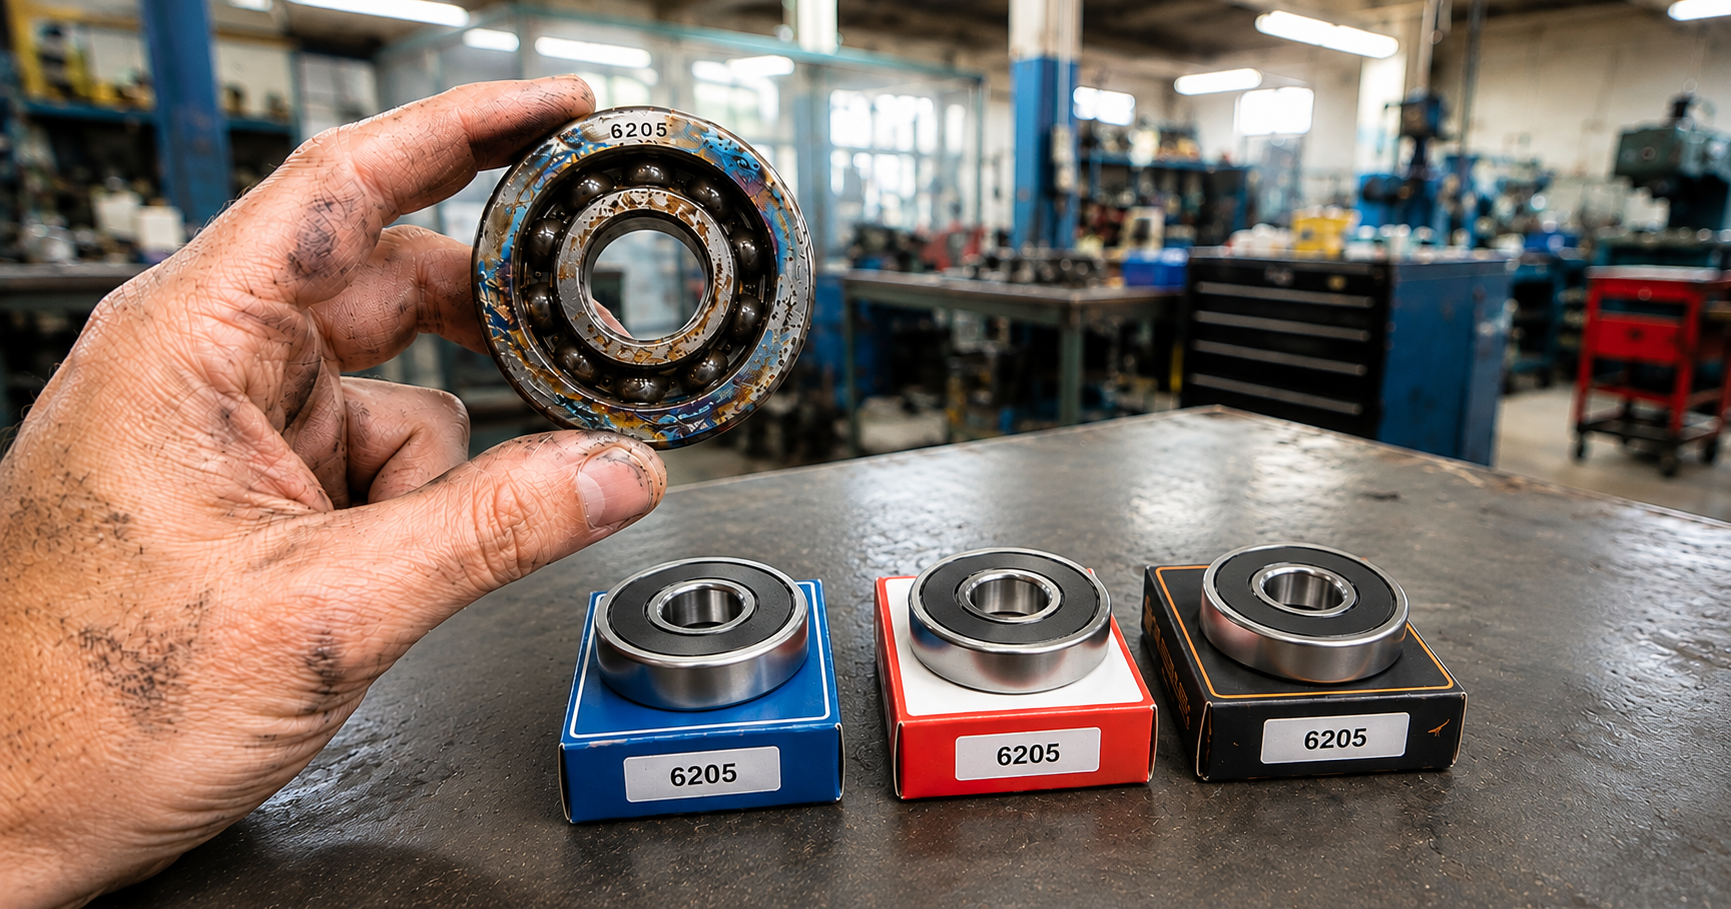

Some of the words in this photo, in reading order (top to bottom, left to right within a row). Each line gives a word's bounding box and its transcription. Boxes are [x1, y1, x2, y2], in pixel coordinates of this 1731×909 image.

[610, 122, 667, 139] 6205
[1304, 727, 1367, 750] 6205
[997, 743, 1060, 766] 6205
[670, 763, 737, 787] 6205
